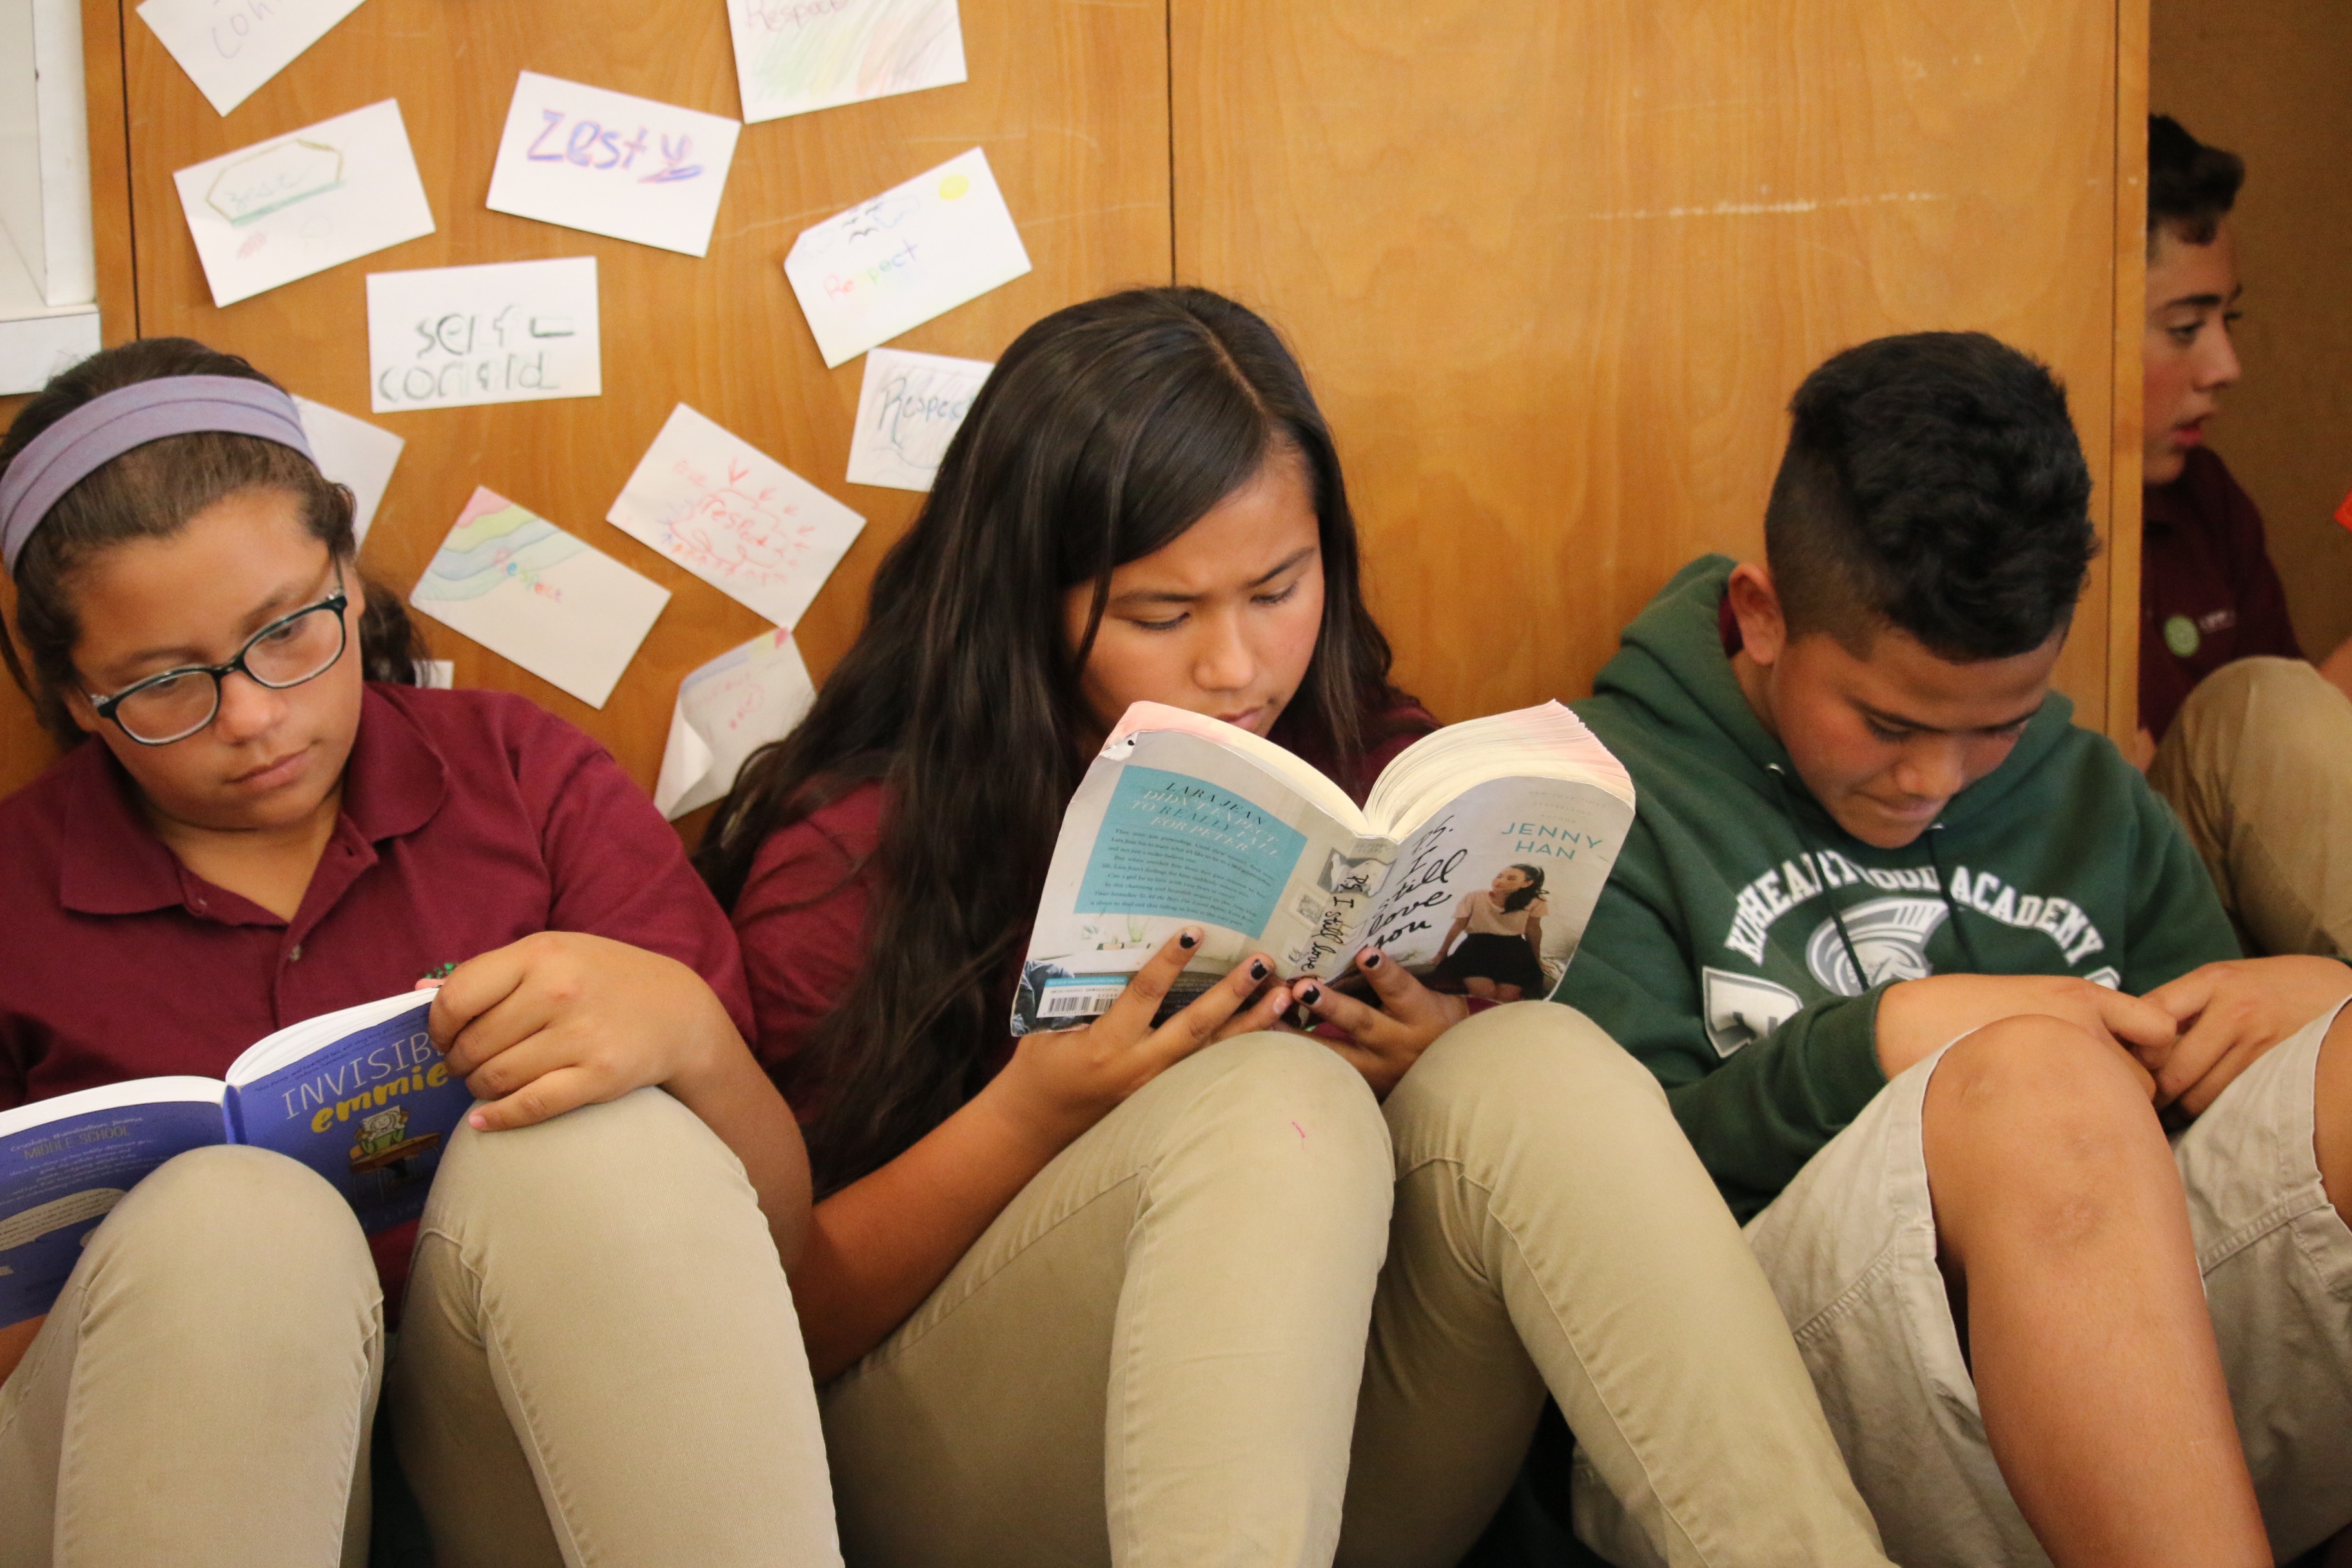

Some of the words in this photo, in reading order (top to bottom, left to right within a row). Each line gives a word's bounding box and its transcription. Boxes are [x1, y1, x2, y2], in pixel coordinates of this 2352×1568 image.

[823, 237, 919, 301] Respect
[877, 375, 977, 450] Respec
[1132, 799, 1157, 812] TO
[1159, 806, 1230, 832] REALLY
[1166, 782, 1216, 803] LARA
[1219, 799, 1266, 825] JEAN
[1150, 816, 1188, 830] FOR
[1189, 825, 1250, 852] PETER
[1501, 822, 1603, 849] JENNY
[1515, 840, 1576, 861] HAN
[1372, 848, 1468, 919] still
[1333, 896, 1354, 908] I
[1367, 891, 1453, 937] love
[1950, 865, 2105, 967] ACADEMY
[1311, 911, 1344, 945] still
[1360, 920, 1432, 951] you
[1301, 942, 1337, 972] love
[282, 1032, 445, 1121] INVISIB
[311, 1062, 449, 1133] emmie
[23, 1137, 72, 1161] MIDDLE
[78, 1125, 131, 1144] SCHOOL
